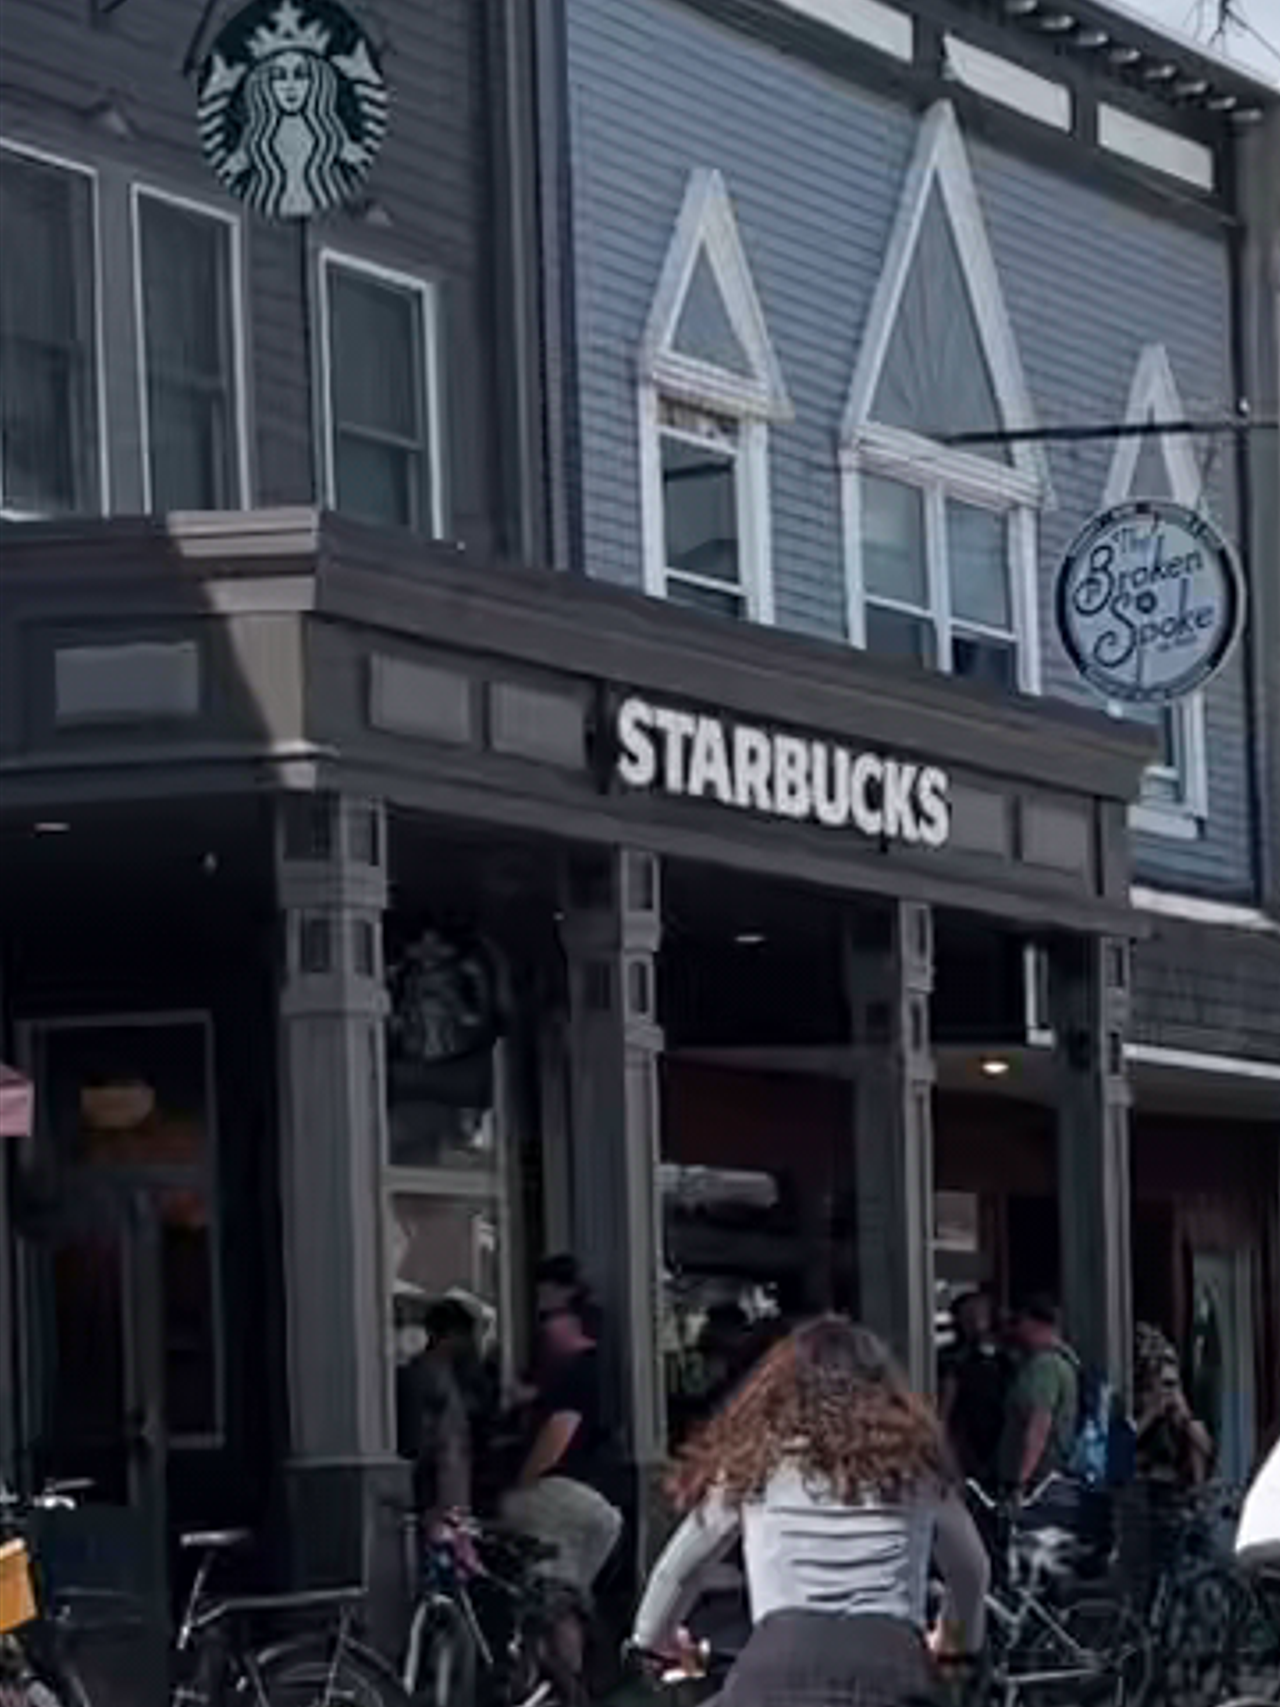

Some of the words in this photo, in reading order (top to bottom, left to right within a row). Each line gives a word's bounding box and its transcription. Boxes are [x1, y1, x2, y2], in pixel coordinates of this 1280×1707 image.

[1074, 535, 1204, 616] Broken
[1094, 577, 1215, 685] Spoke
[617, 697, 951, 846] STARBUCKS
